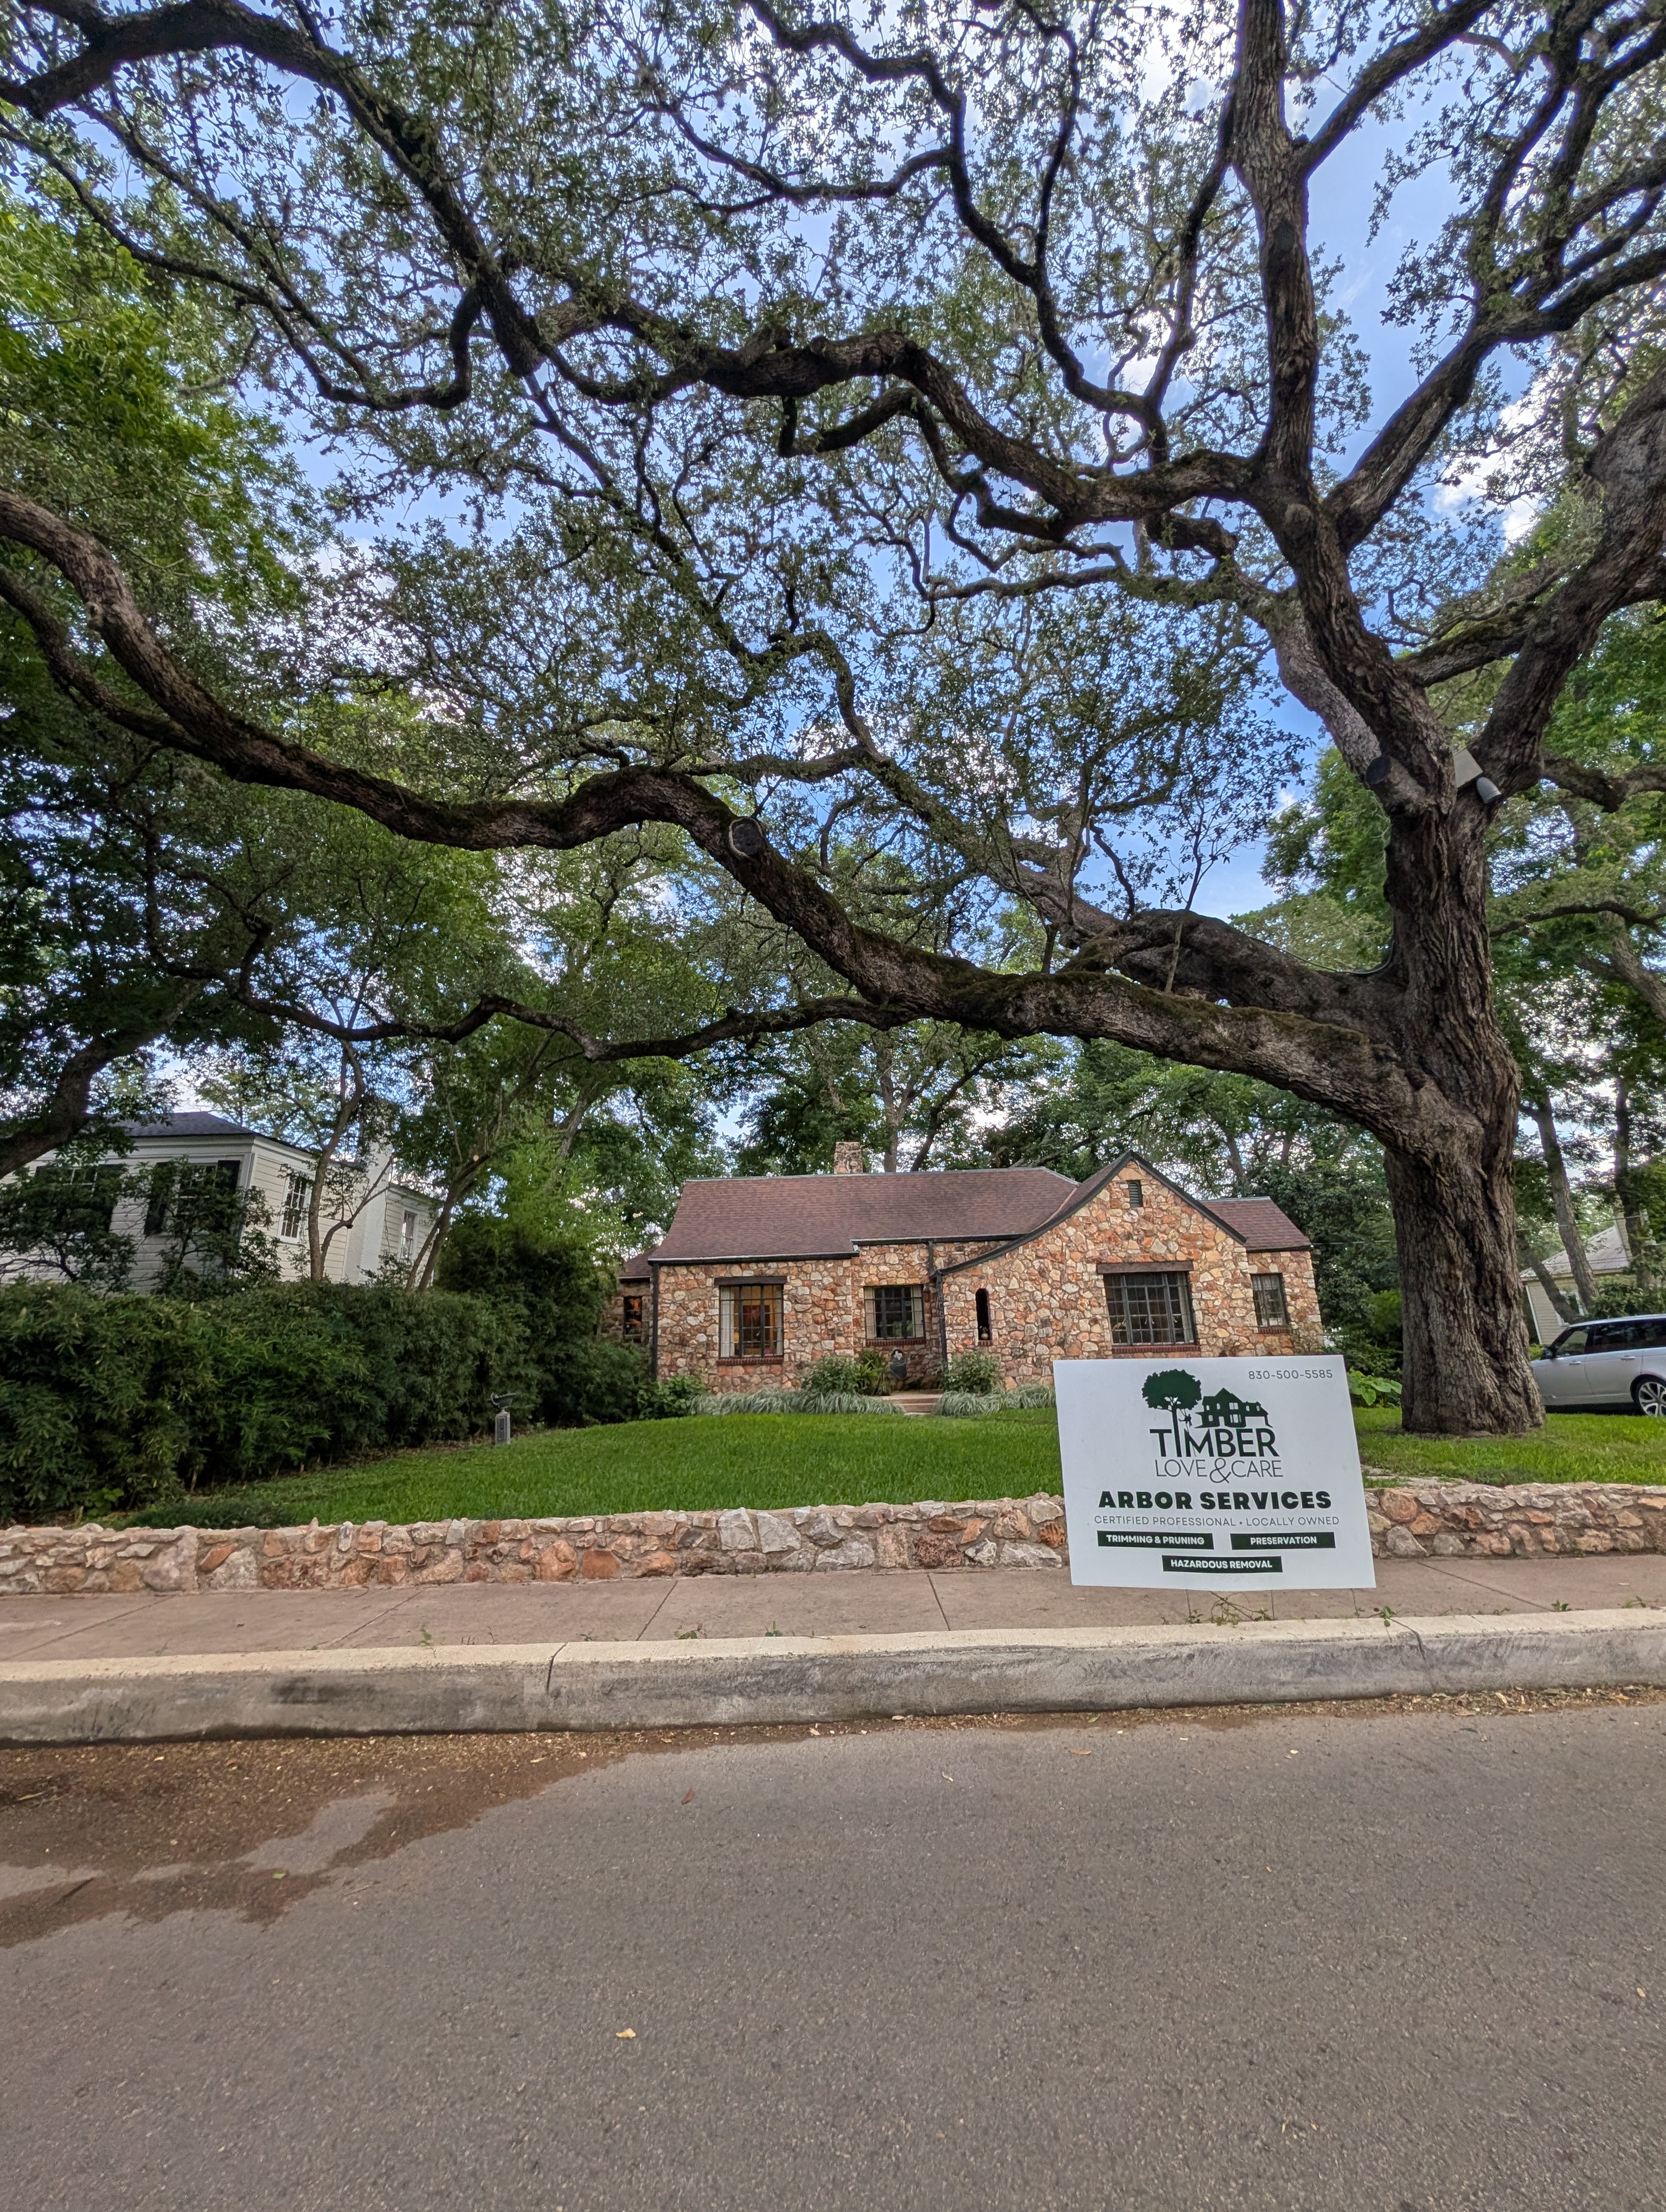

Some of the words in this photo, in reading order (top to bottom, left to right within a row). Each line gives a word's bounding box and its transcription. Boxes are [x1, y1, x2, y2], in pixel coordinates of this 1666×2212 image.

[1248, 1369, 1333, 1380] 830-500-5585
[1150, 1427, 1279, 1457] TIMBER
[1098, 1490, 1193, 1509] ARBOR
[1200, 1490, 1331, 1509] SERVICES
[1094, 1515, 1149, 1525] CERTIFIED
[1152, 1516, 1236, 1526] PROFESSIONAL
[1246, 1517, 1295, 1526] LOCALLY
[1298, 1516, 1340, 1526] OWNED
[1106, 1534, 1152, 1544] TRIMMING
[1154, 1535, 1161, 1544] &
[1162, 1536, 1204, 1545] PRUNING
[1250, 1536, 1317, 1545] PRESERVATION
[1170, 1559, 1228, 1569] HAZARDOUS
[1229, 1560, 1273, 1568] REMOVAL
